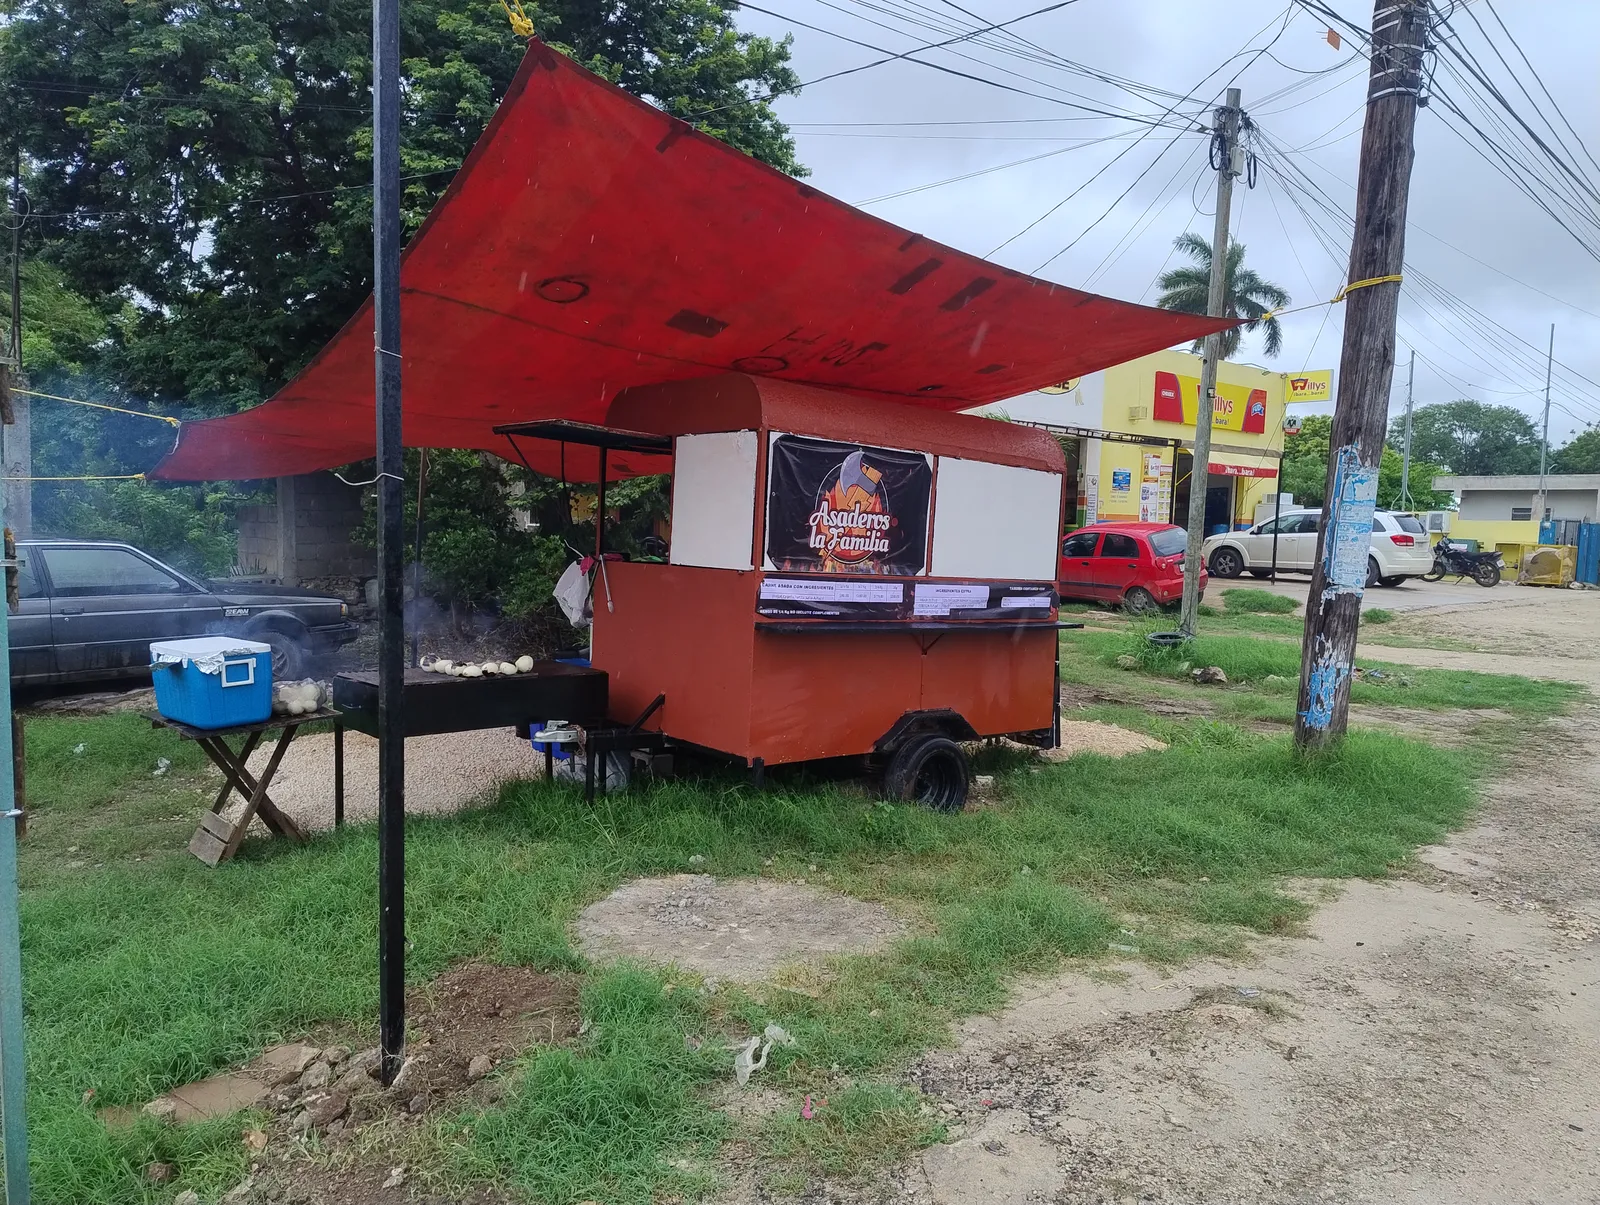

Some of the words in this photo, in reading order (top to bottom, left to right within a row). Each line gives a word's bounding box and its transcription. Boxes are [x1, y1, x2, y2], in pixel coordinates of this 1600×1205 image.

[1290, 378, 1326, 391] Willys
[809, 500, 890, 530] Asaderos
[809, 525, 826, 549] la
[827, 527, 890, 553] Familia
